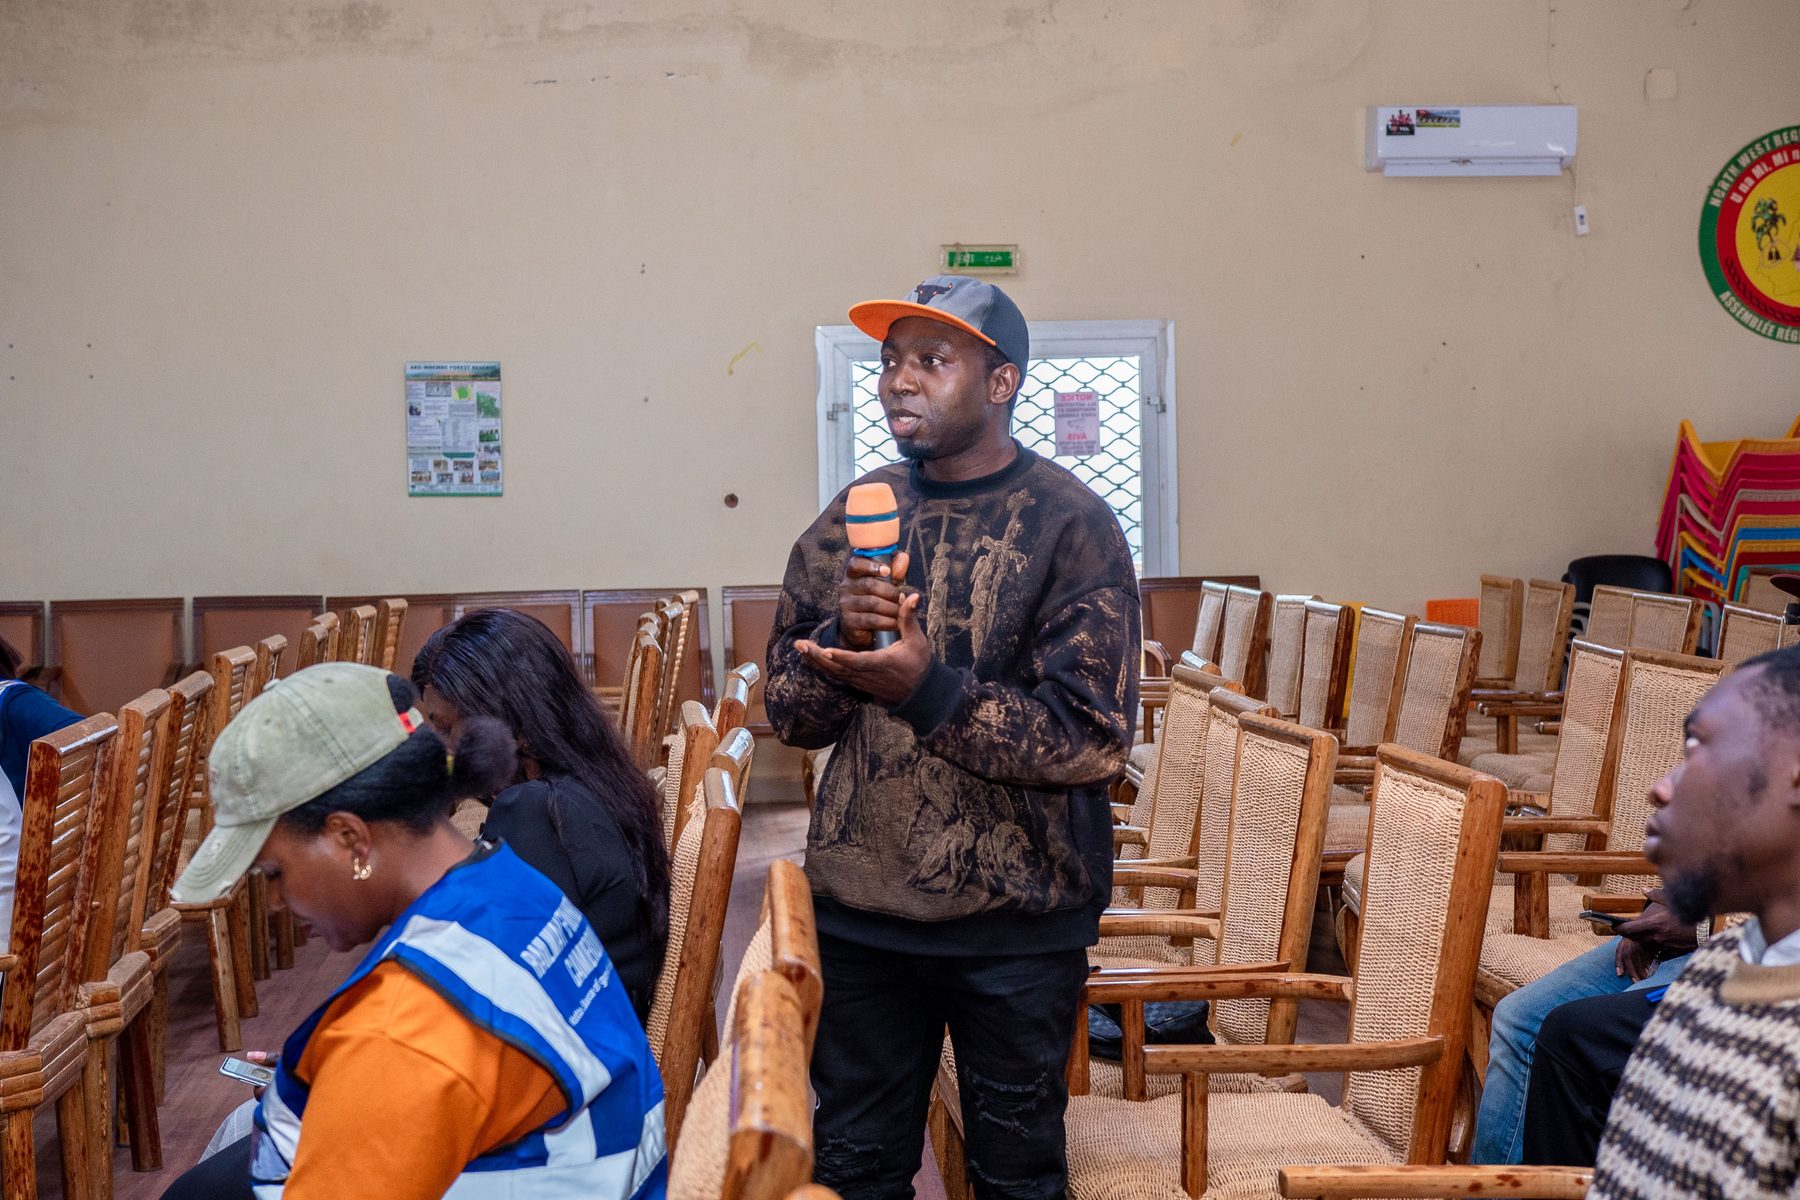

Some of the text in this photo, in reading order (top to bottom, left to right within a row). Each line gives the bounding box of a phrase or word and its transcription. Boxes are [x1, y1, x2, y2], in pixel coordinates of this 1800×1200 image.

[1709, 129, 1800, 207] NORTH WEST REG
[1775, 326, 1800, 342] RÉG
